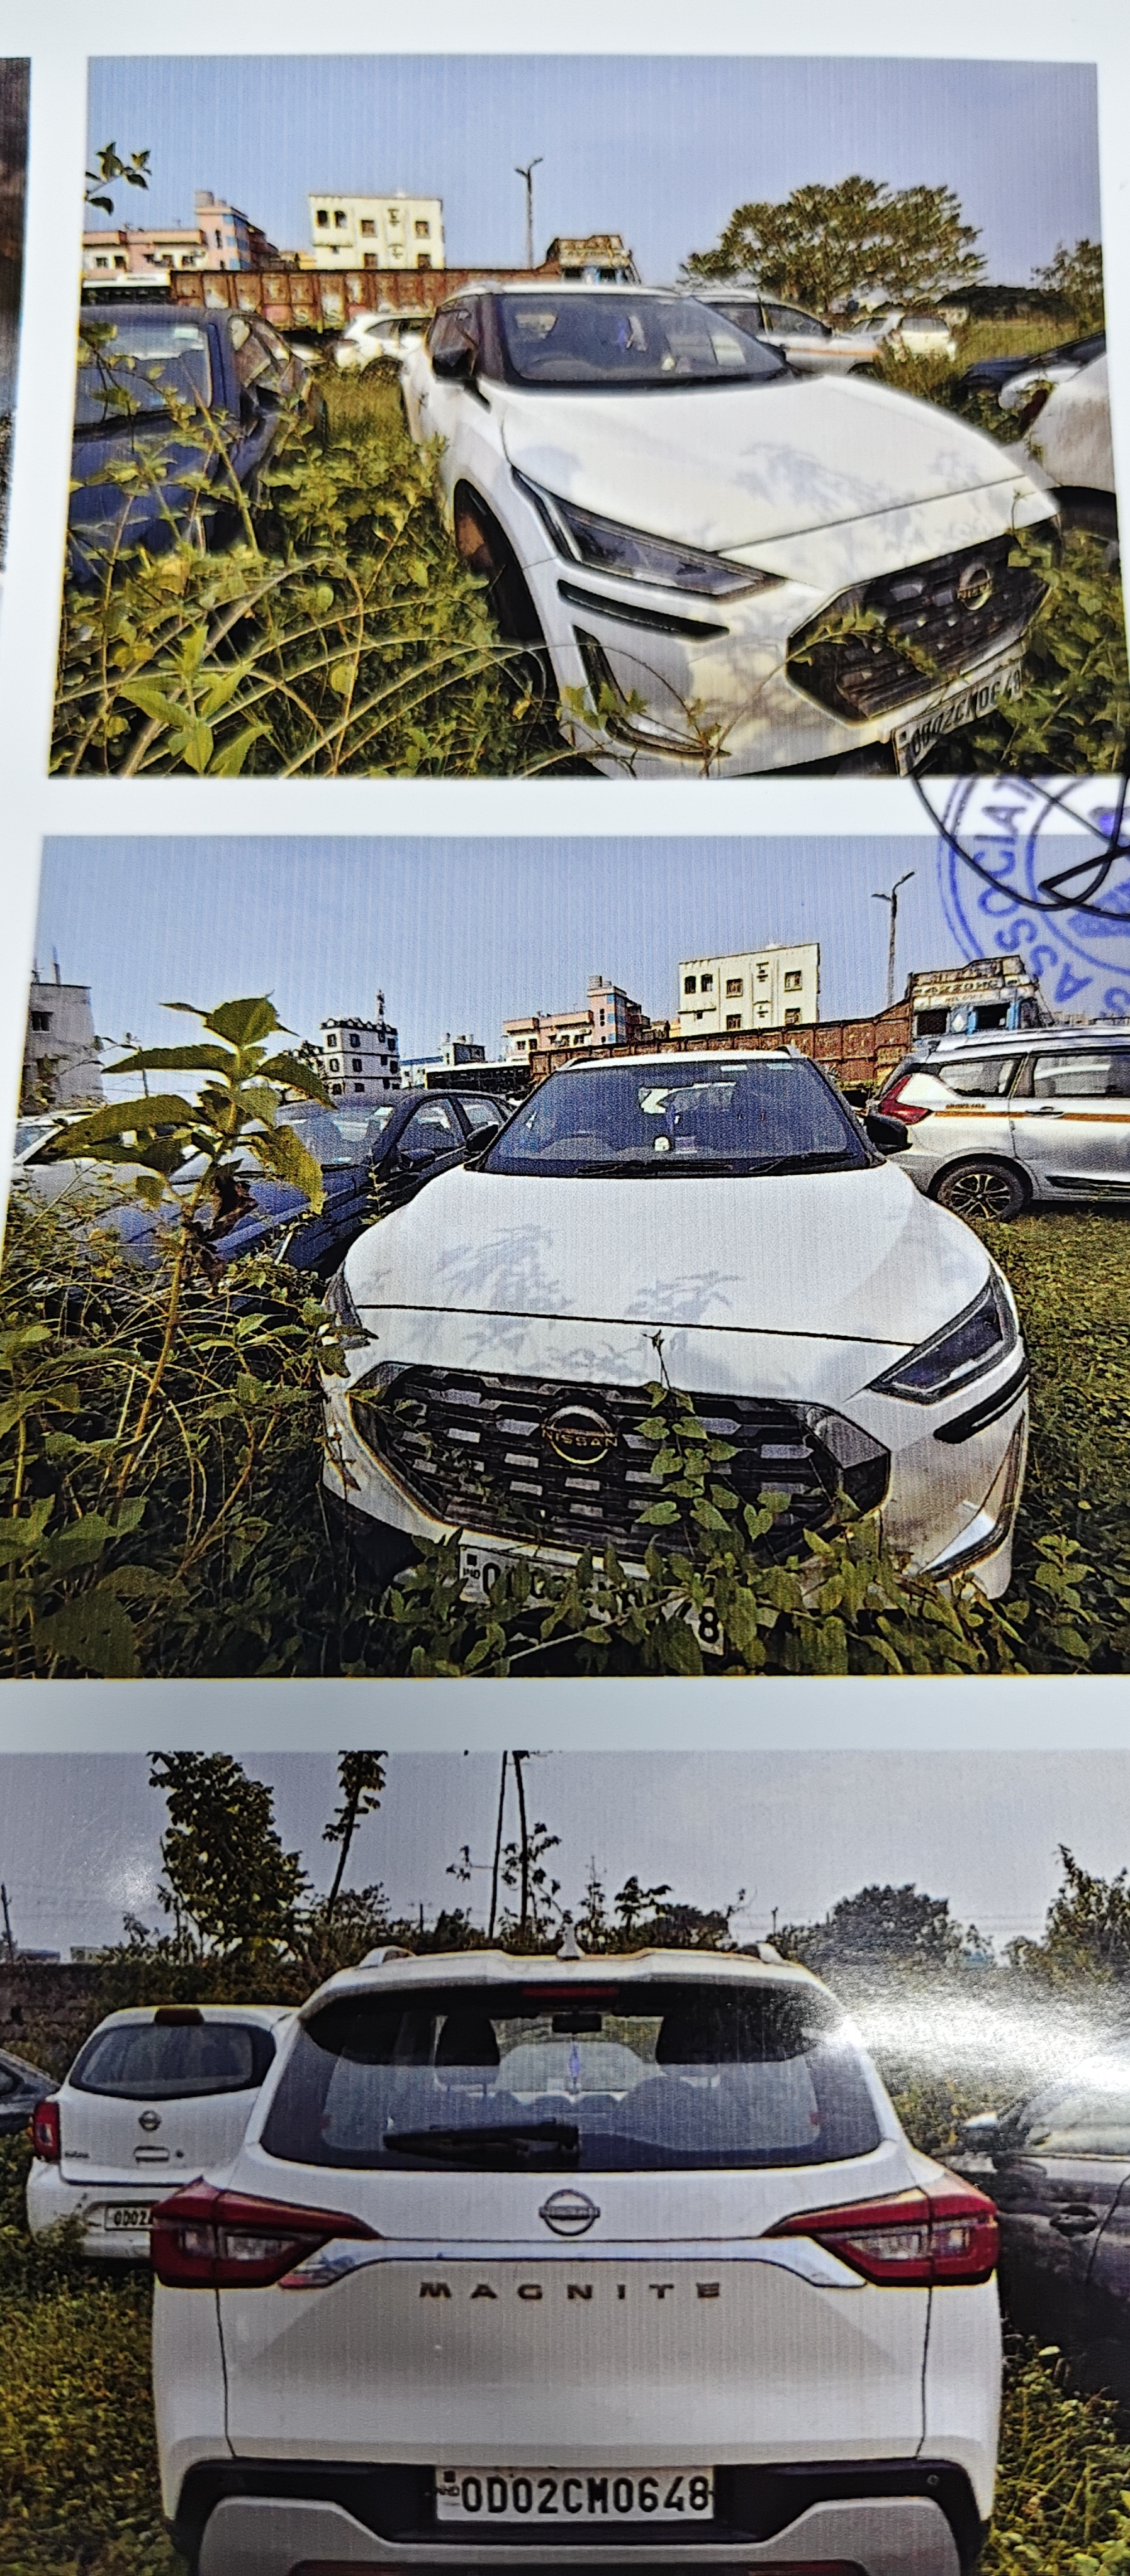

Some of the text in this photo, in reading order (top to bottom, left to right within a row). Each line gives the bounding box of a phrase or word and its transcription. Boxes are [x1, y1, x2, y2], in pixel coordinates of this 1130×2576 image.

[542, 1430, 618, 1447] NISSAN
[420, 2282, 720, 2300] MAGNITE
[461, 2476, 710, 2513] OD02CM0648
